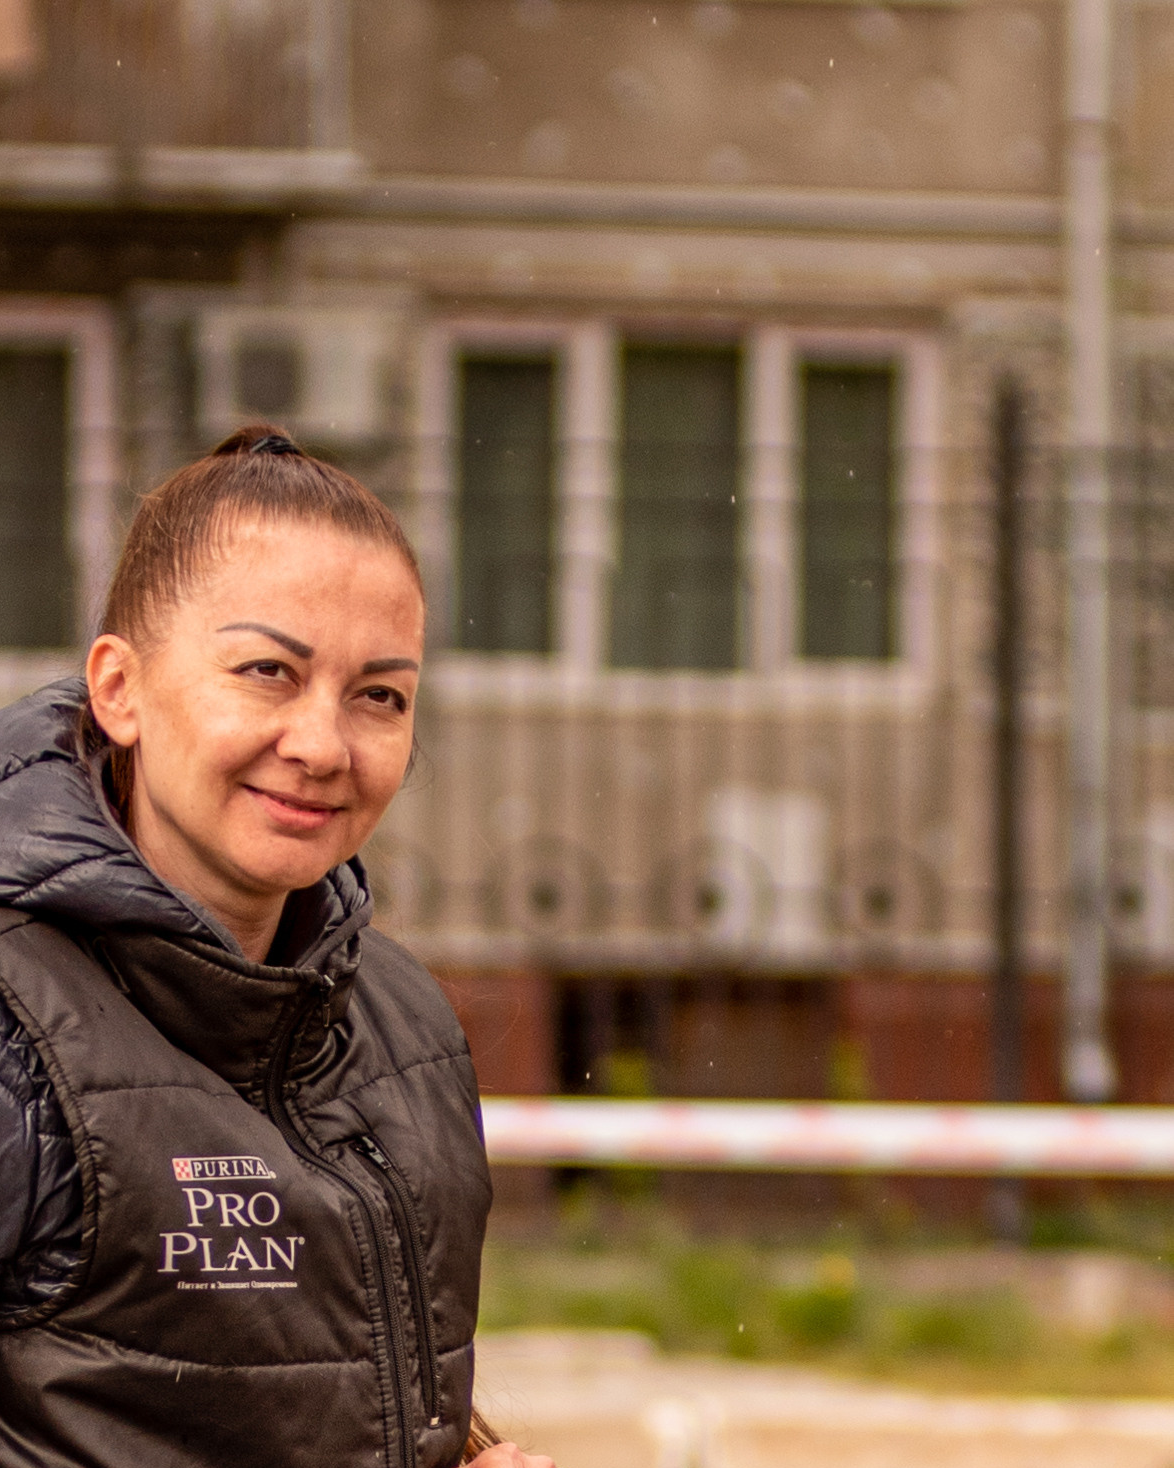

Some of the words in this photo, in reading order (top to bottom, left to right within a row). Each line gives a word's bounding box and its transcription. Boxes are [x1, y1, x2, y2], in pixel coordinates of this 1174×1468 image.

[193, 1160, 267, 1178] PURINA
[181, 1187, 280, 1227] PRO
[157, 1232, 299, 1273] PLAN
